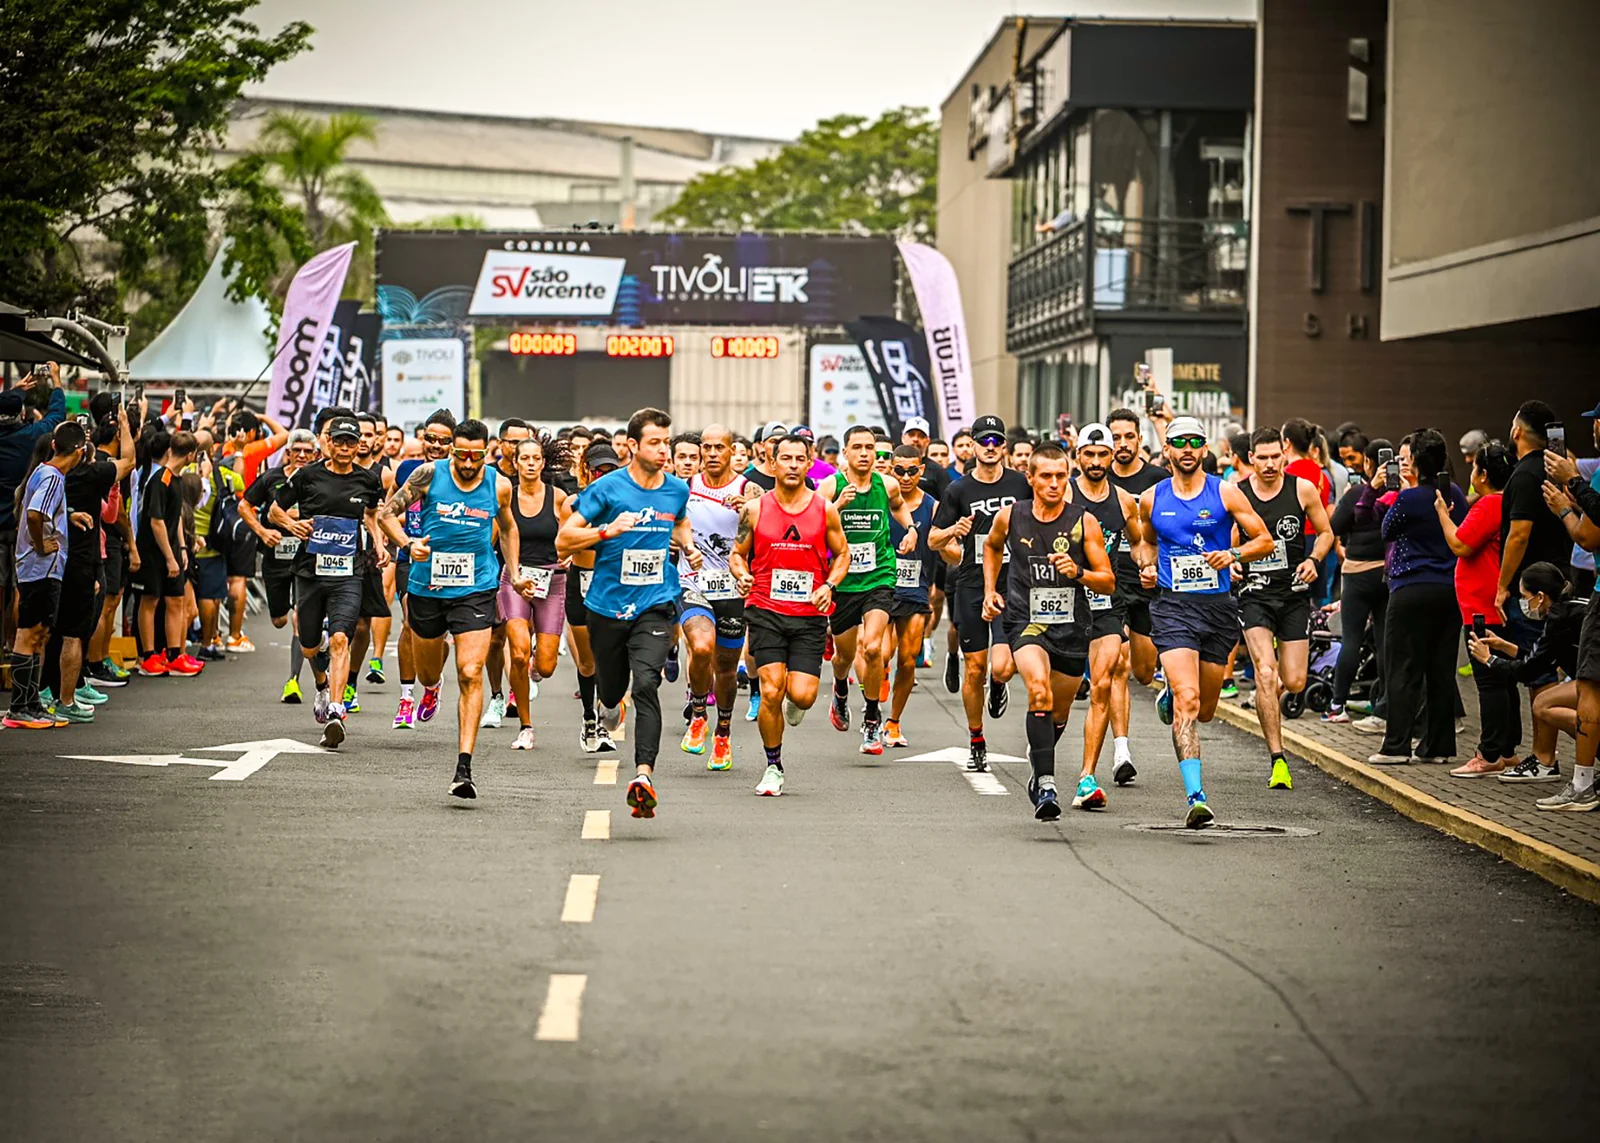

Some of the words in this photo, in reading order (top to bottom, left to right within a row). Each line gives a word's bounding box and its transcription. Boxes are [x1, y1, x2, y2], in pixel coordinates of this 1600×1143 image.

[504, 240, 591, 252] CORRIDA
[492, 266, 531, 298] SV
[530, 265, 569, 284] são
[525, 281, 606, 299] vicente
[751, 274, 809, 302] 21K
[509, 333, 576, 355] 000009
[607, 335, 674, 357] 002007
[1123, 390, 1230, 419] COELINHA
[312, 528, 354, 545] danny
[322, 556, 344, 567] 1046
[632, 561, 653, 573] 1169
[440, 564, 462, 575] 1170
[896, 568, 912, 579] 083
[1182, 567, 1204, 579] 966
[707, 580, 725, 590] 1016
[780, 580, 800, 591] 964
[1041, 600, 1062, 611] 962
